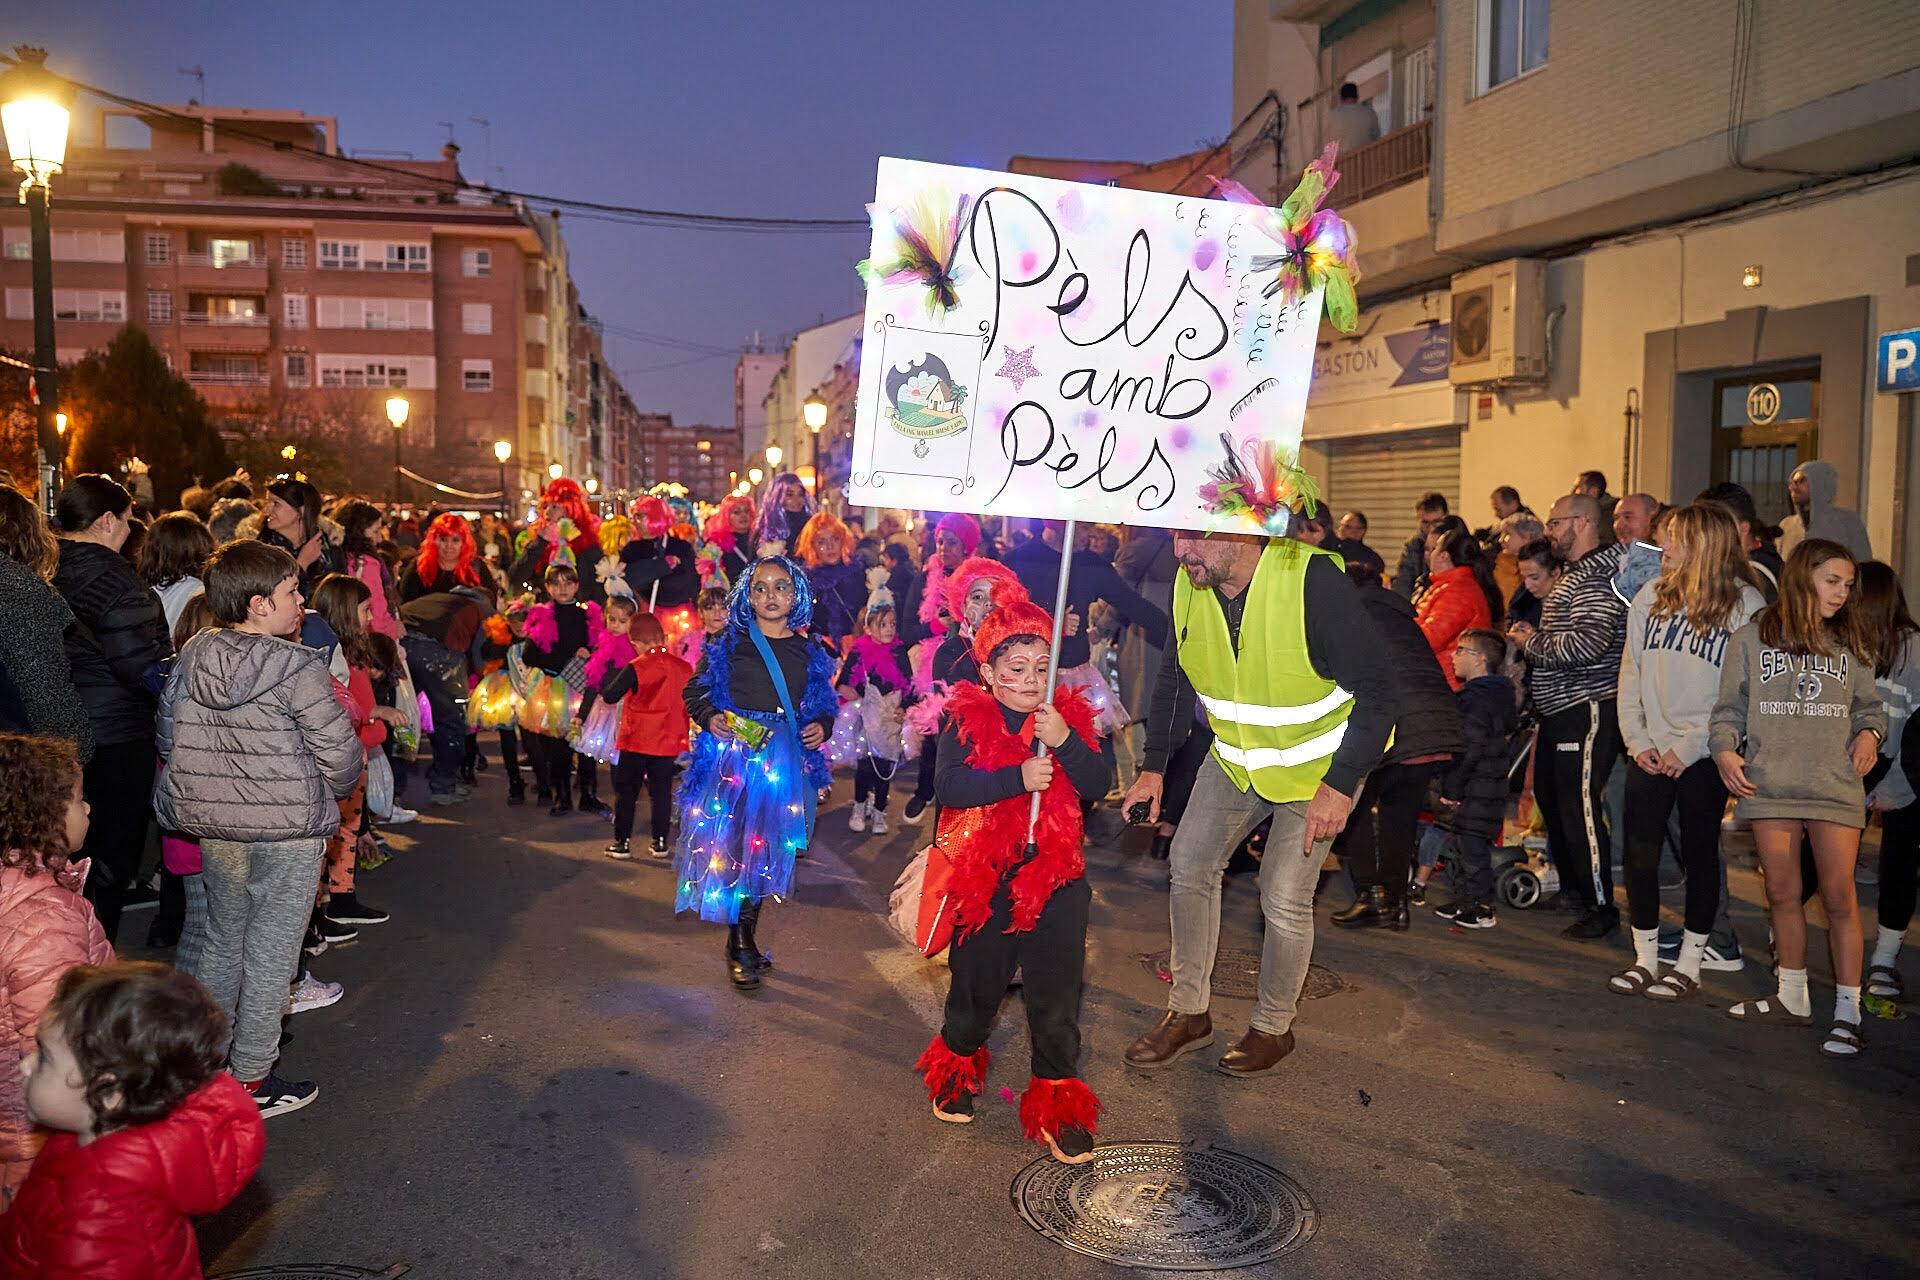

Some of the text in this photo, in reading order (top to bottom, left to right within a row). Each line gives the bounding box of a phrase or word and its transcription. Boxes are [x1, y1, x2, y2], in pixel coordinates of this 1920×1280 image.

[970, 186, 1229, 361] Pèls
[1059, 354, 1212, 420] amb
[1887, 338, 1917, 385] P
[1750, 391, 1775, 417] 110
[984, 400, 1176, 511] Pèls
[1643, 613, 1731, 668] NEWPORT
